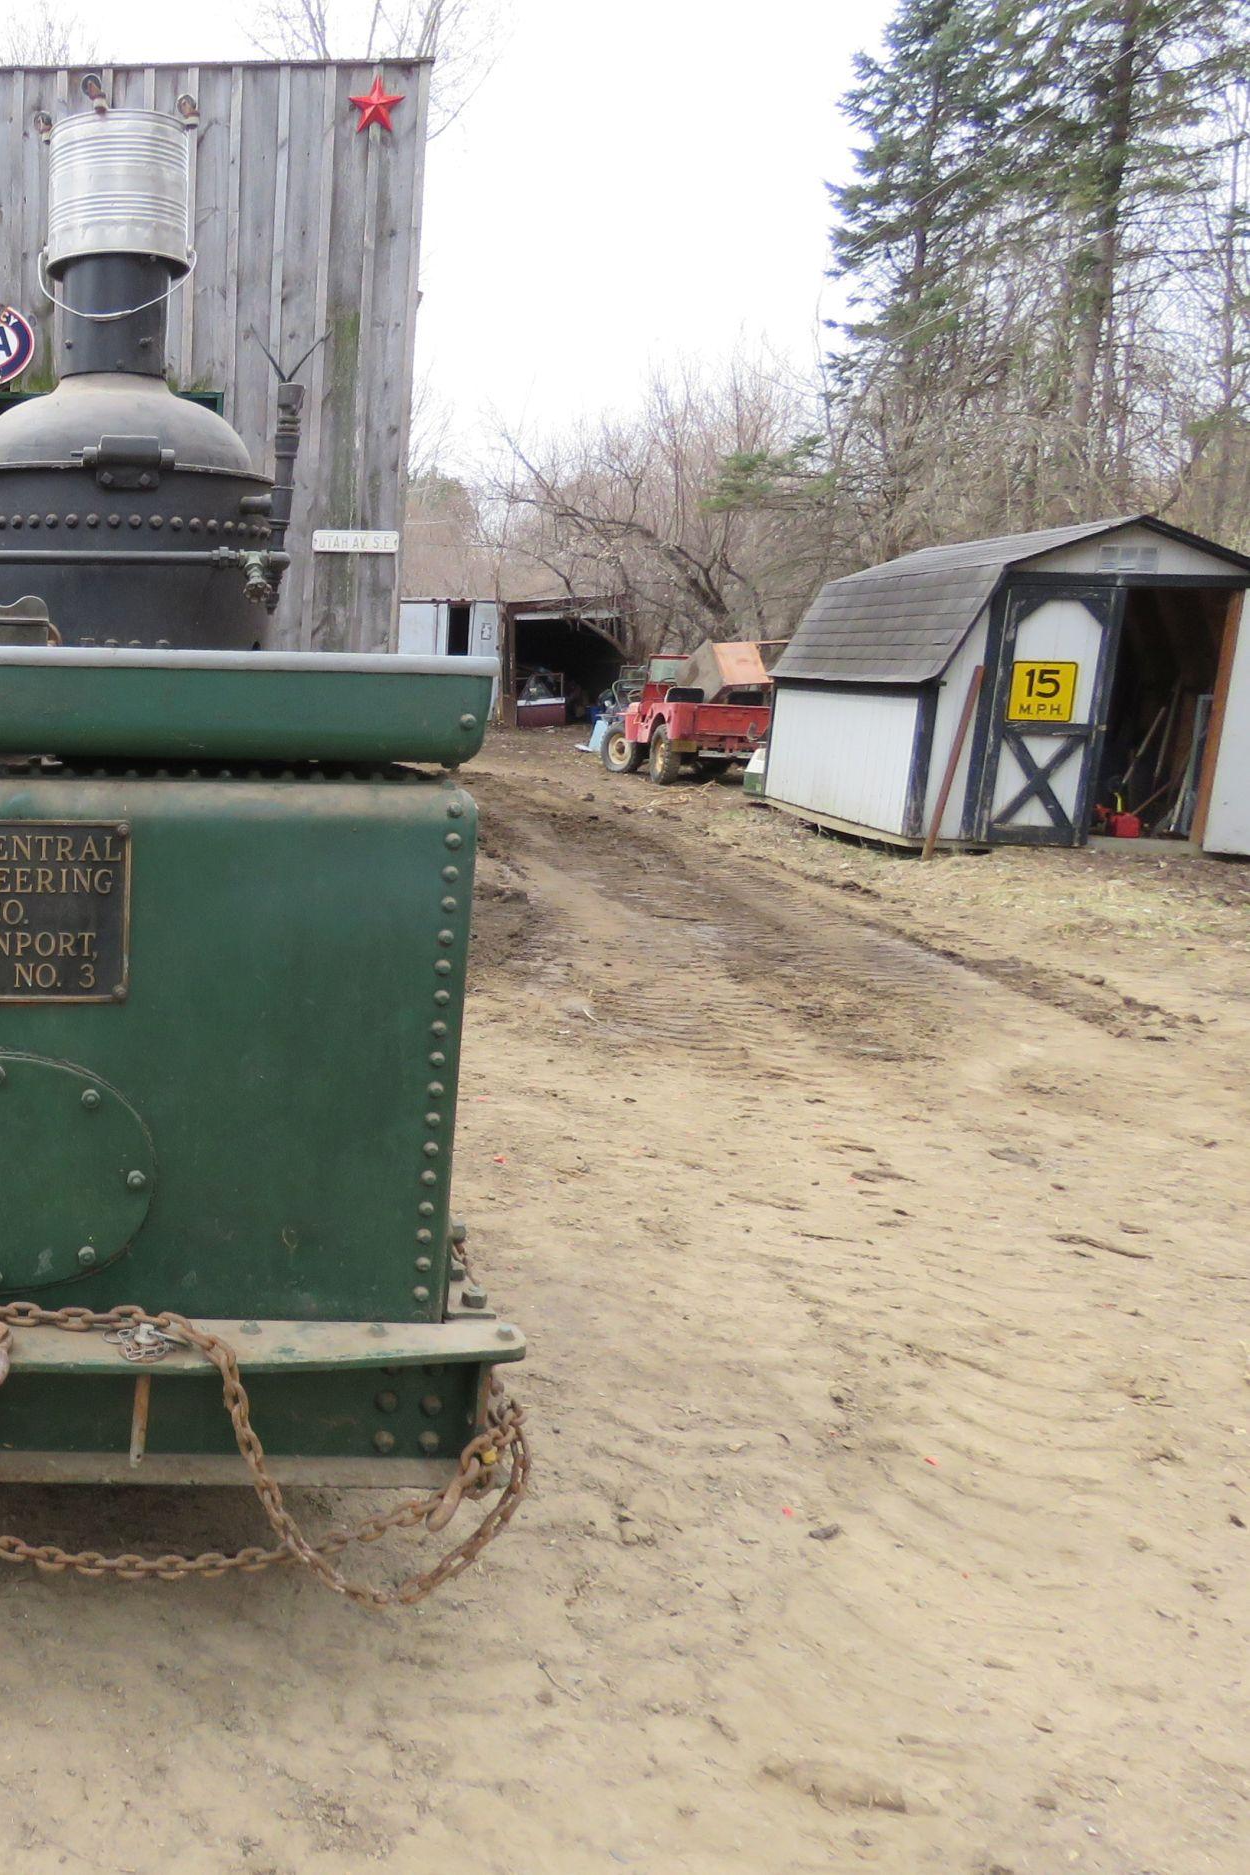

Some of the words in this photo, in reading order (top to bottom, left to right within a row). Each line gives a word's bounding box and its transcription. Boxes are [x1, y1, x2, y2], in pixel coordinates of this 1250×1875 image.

[1025, 669, 1060, 698] 15
[13, 963, 62, 988] NO.
[78, 963, 97, 989] 3
